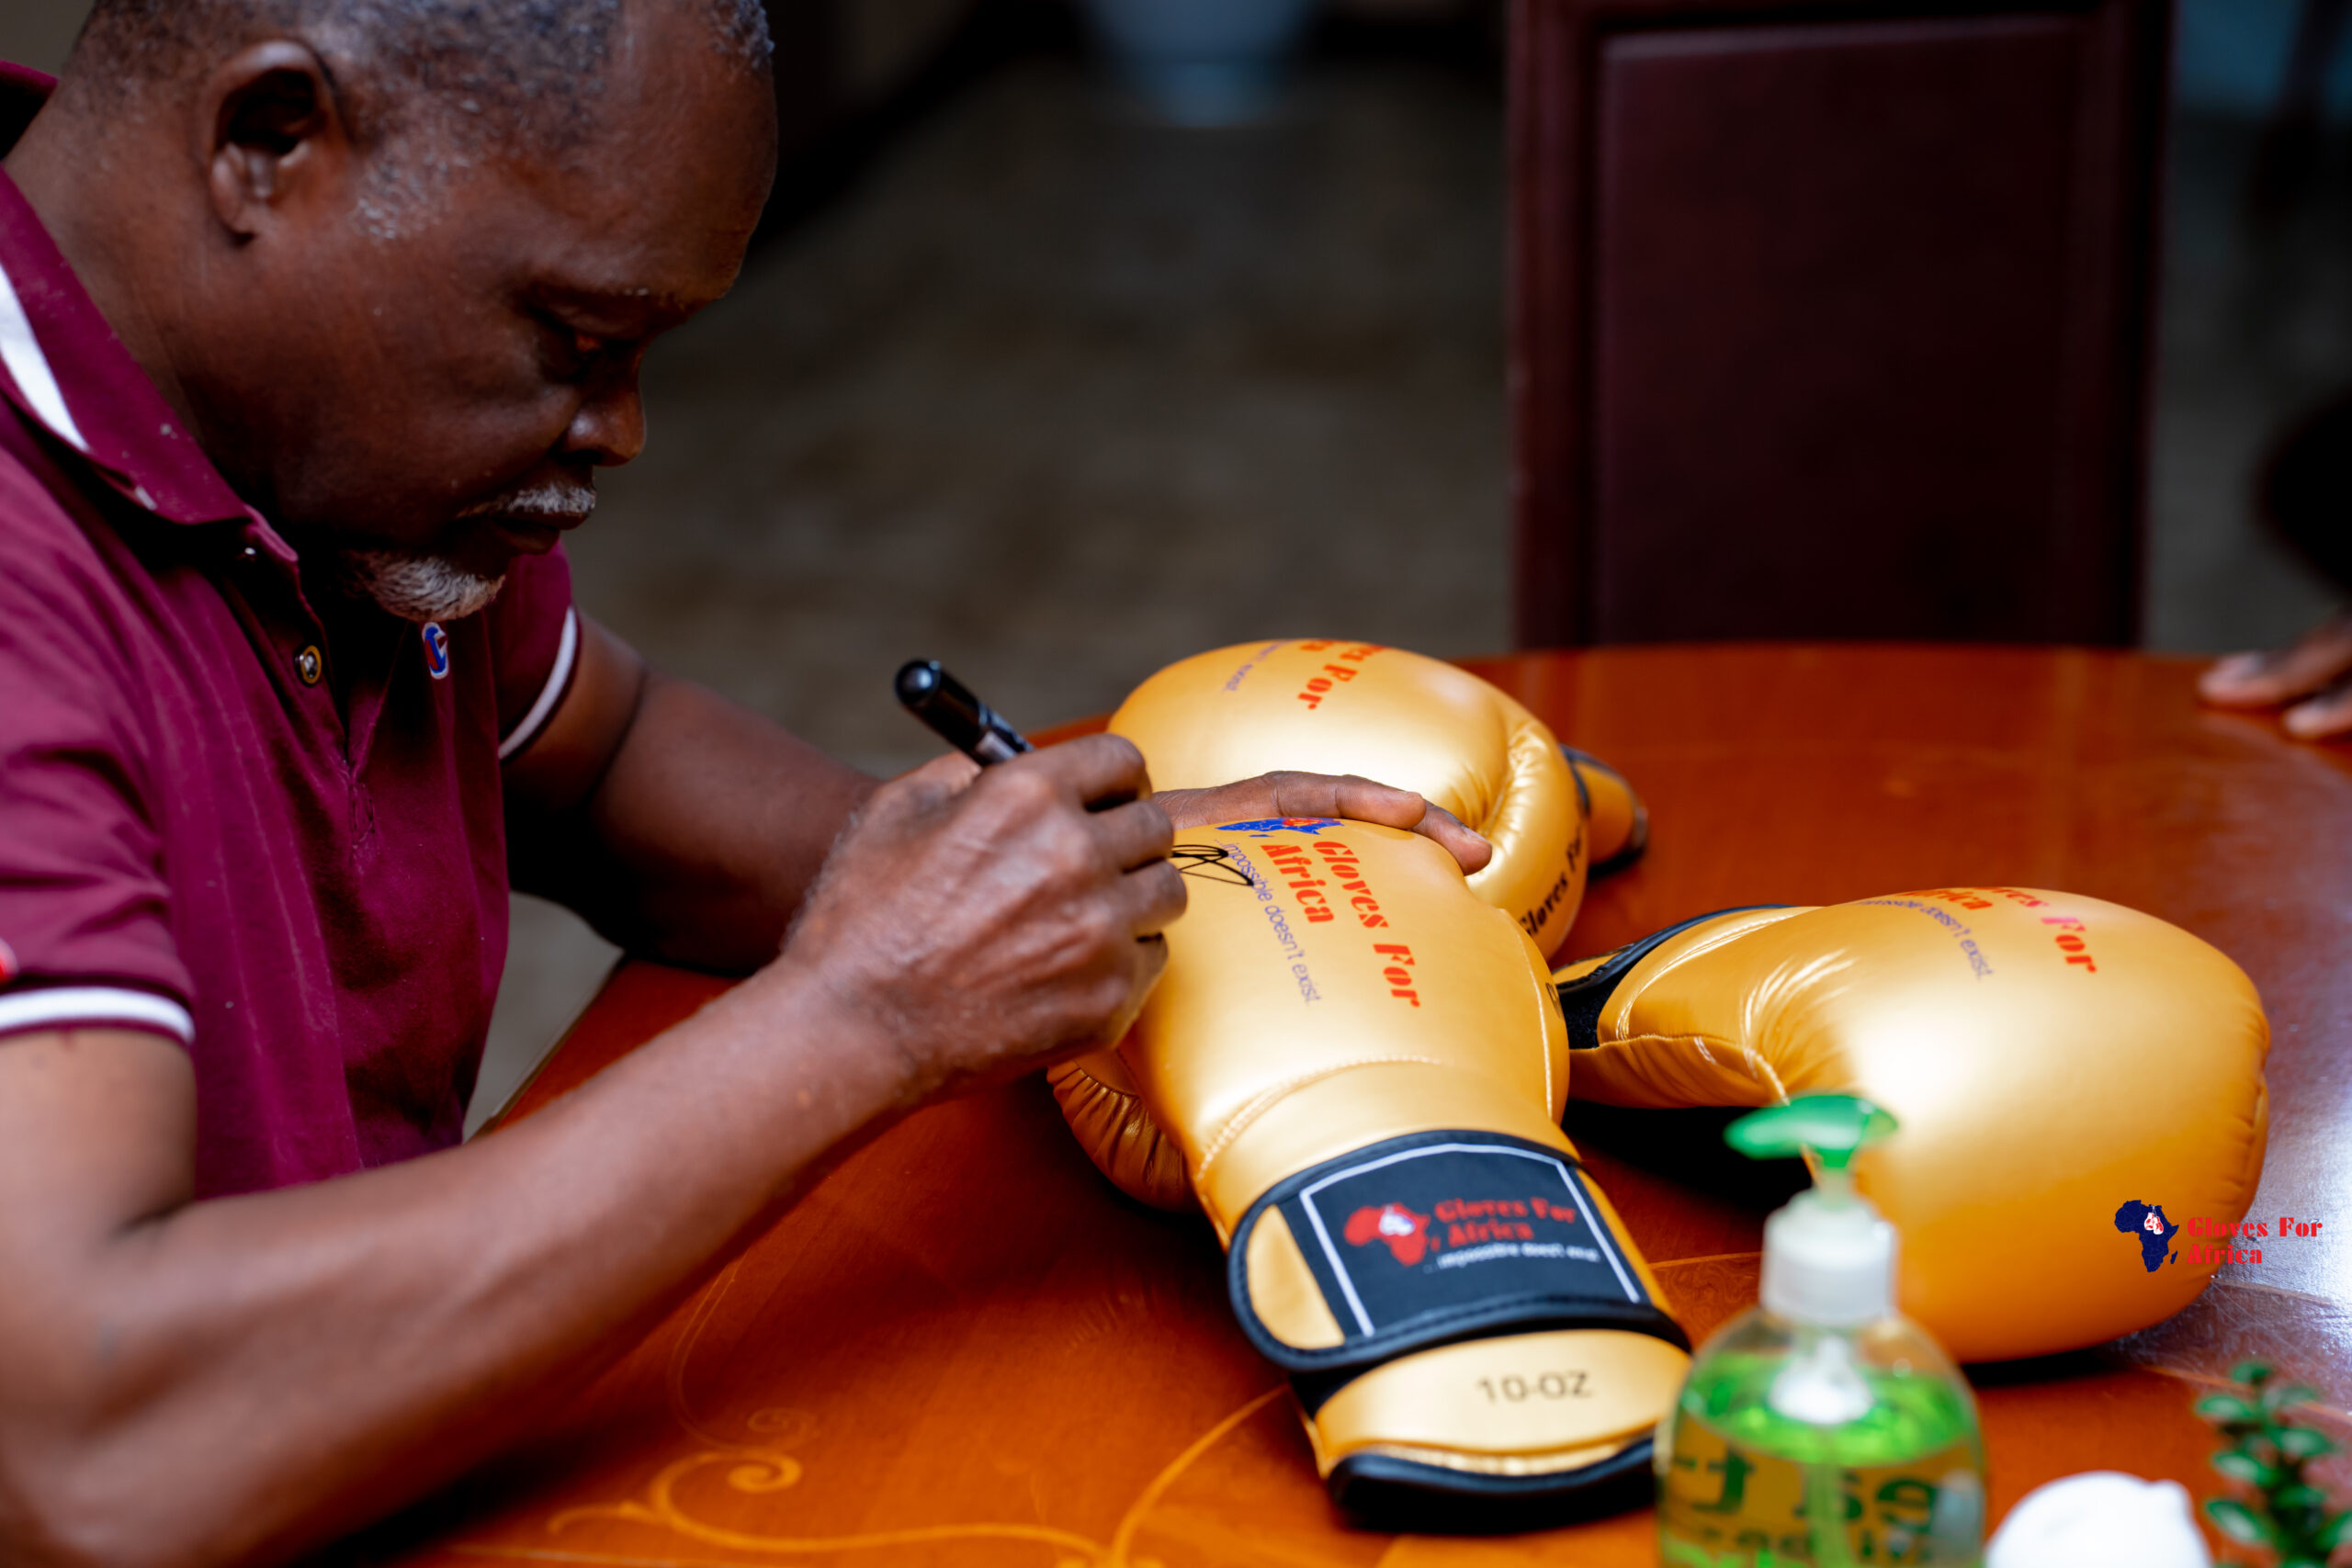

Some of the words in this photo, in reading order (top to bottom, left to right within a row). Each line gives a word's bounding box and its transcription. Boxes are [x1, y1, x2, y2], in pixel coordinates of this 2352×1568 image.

[1260, 844, 1335, 923] Africa
[1312, 840, 1389, 928] Gloves
[1373, 943, 1420, 1008] For
[2040, 916, 2098, 973] For
